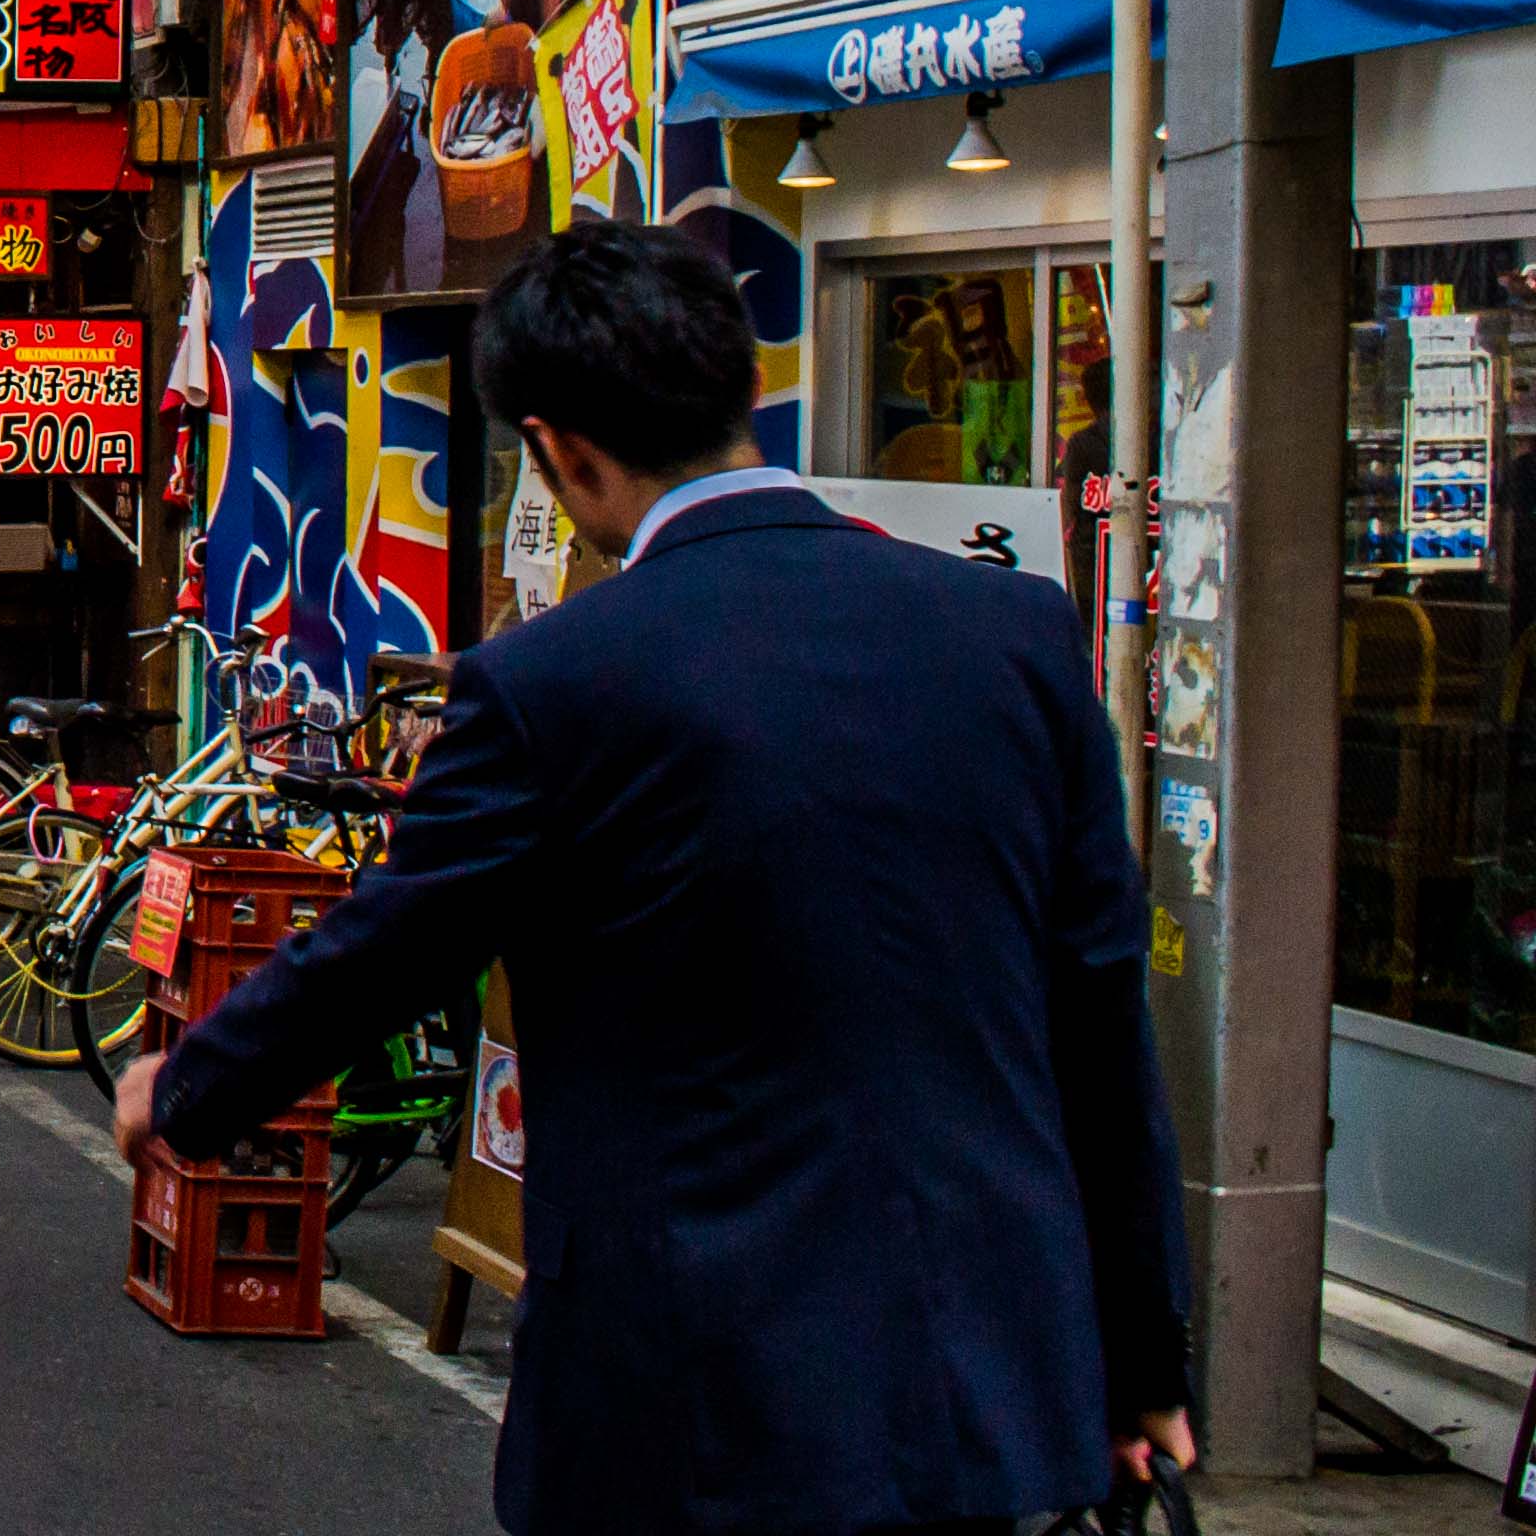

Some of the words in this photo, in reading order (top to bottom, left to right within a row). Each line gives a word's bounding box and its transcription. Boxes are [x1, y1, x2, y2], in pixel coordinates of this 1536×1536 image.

[25, 4, 77, 79] 名物
[868, 5, 1027, 96] 磯丸水産
[14, 348, 116, 363] OKONOMIYAKI
